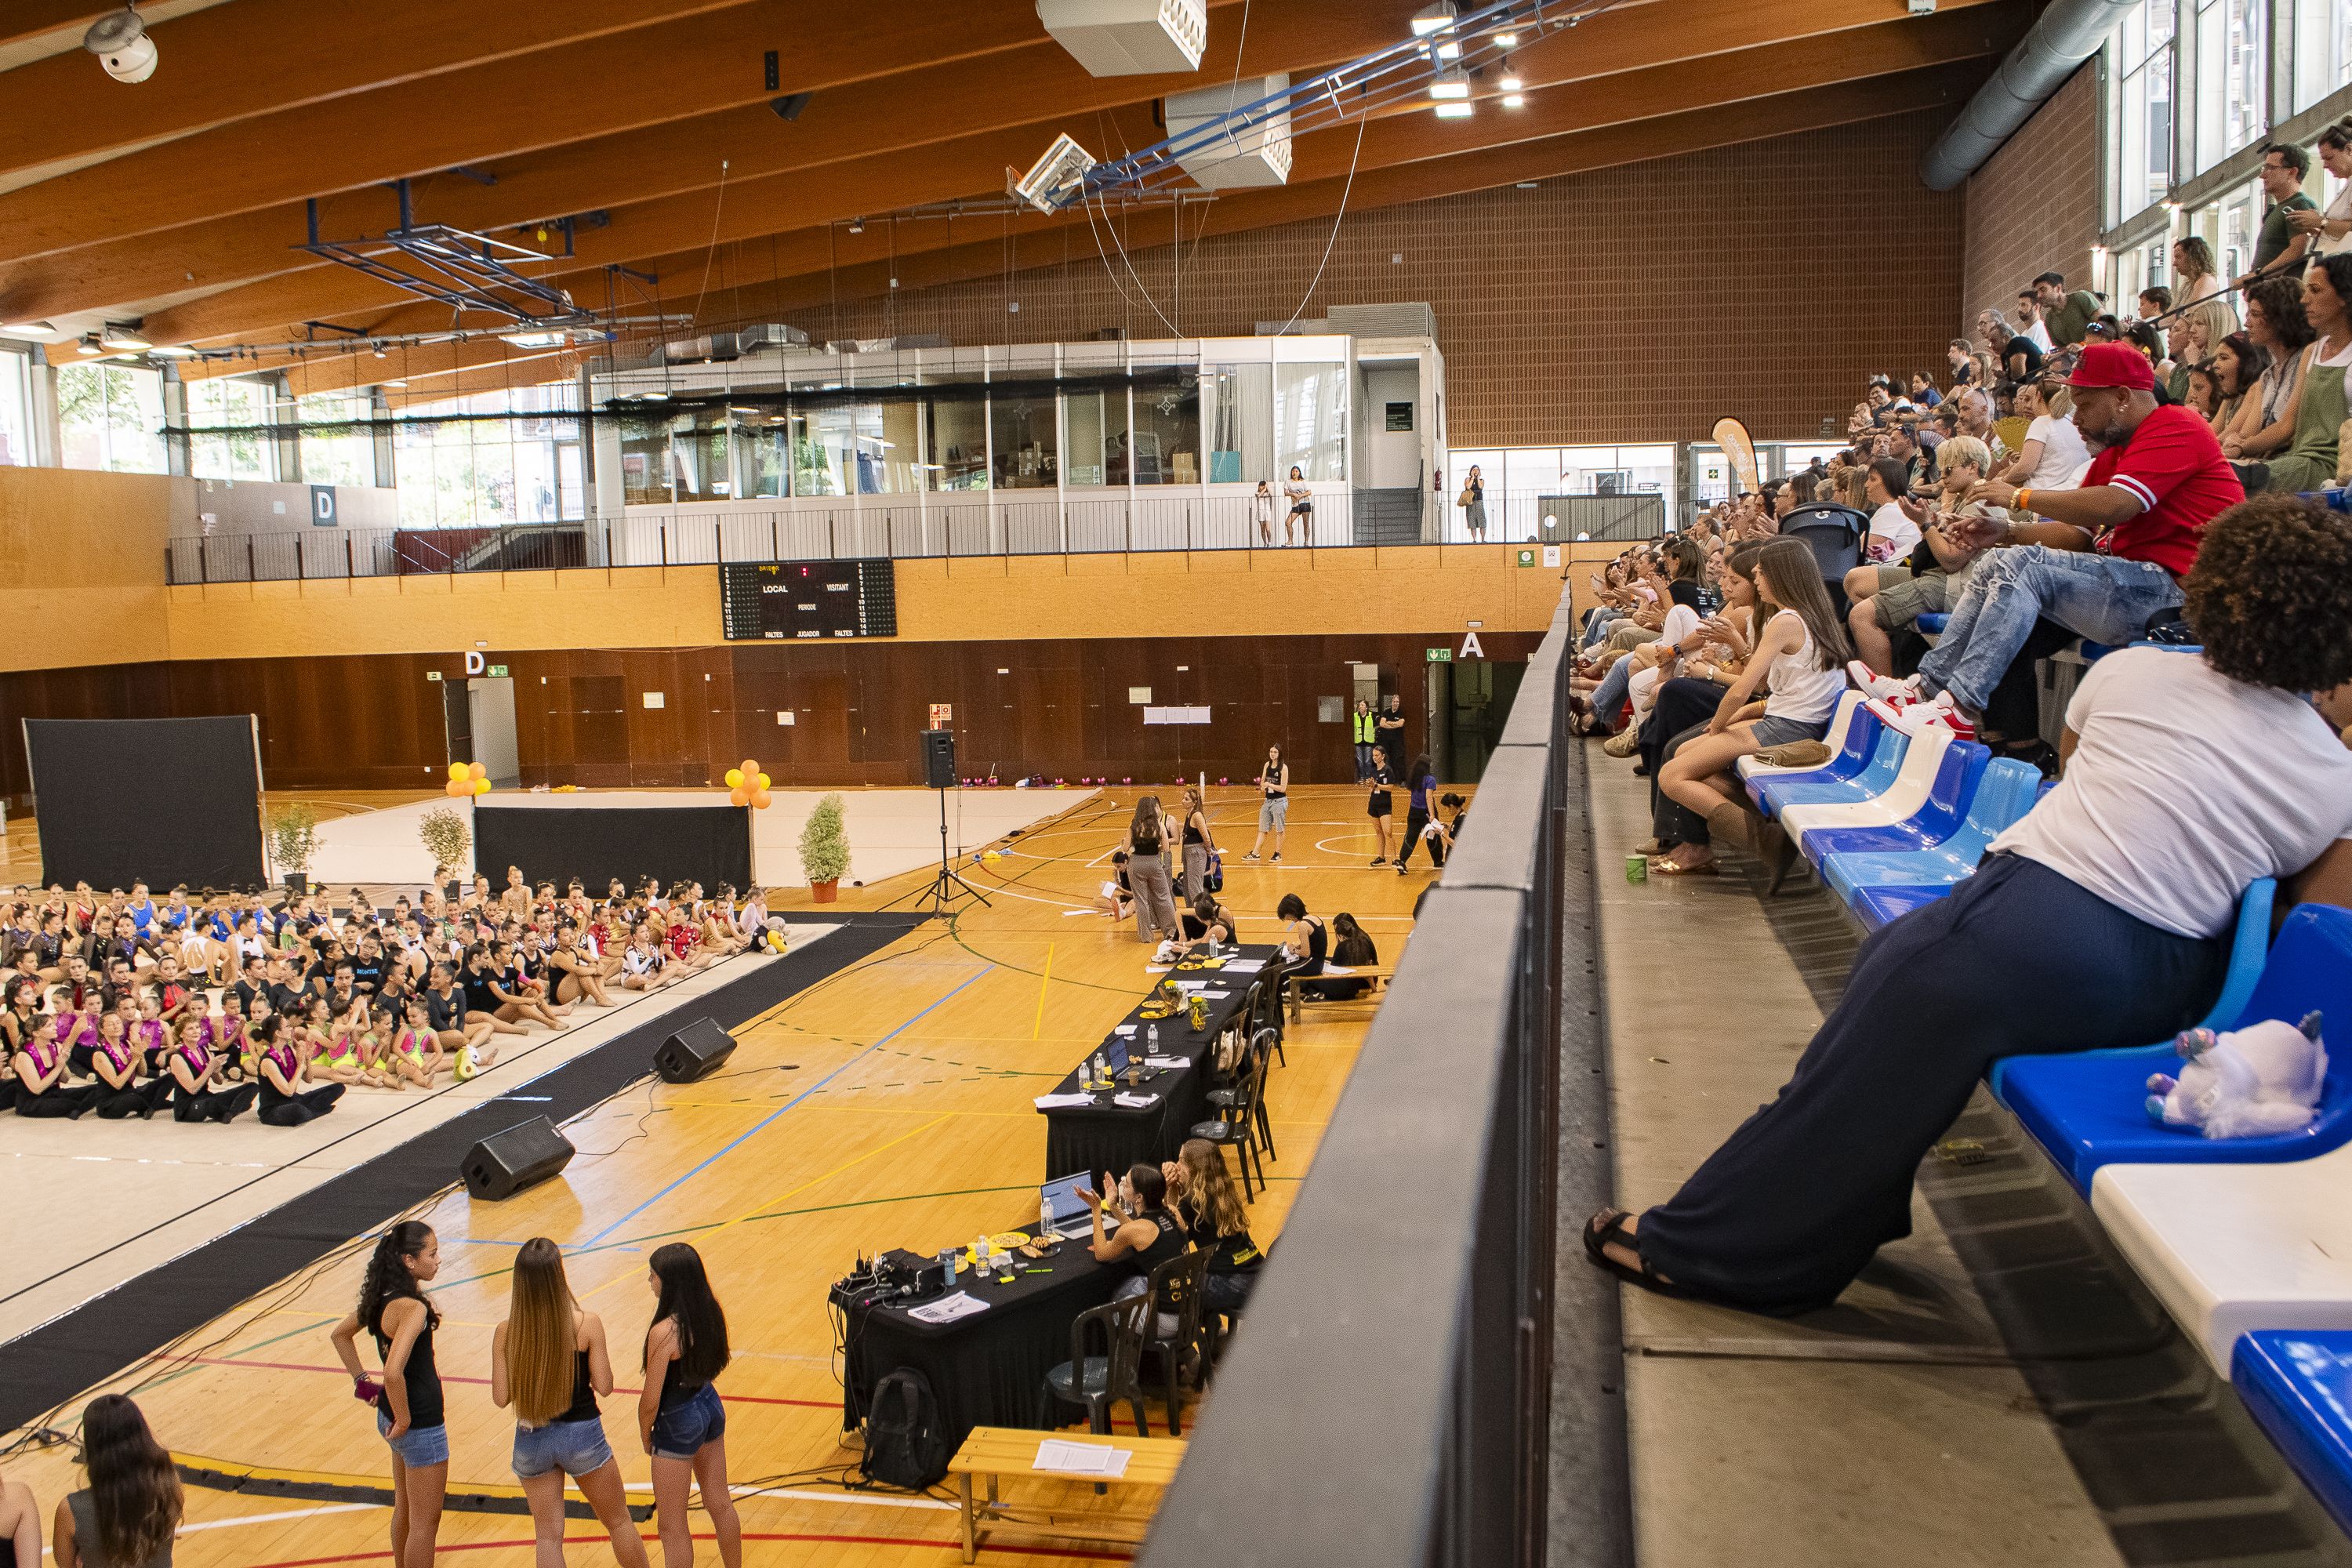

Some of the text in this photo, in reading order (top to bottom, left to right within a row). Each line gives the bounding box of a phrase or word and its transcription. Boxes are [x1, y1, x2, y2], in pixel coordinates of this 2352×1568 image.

[317, 492, 333, 518] D
[762, 585, 789, 593] LOCAL
[1459, 632, 1484, 658] A
[465, 651, 485, 674] D
